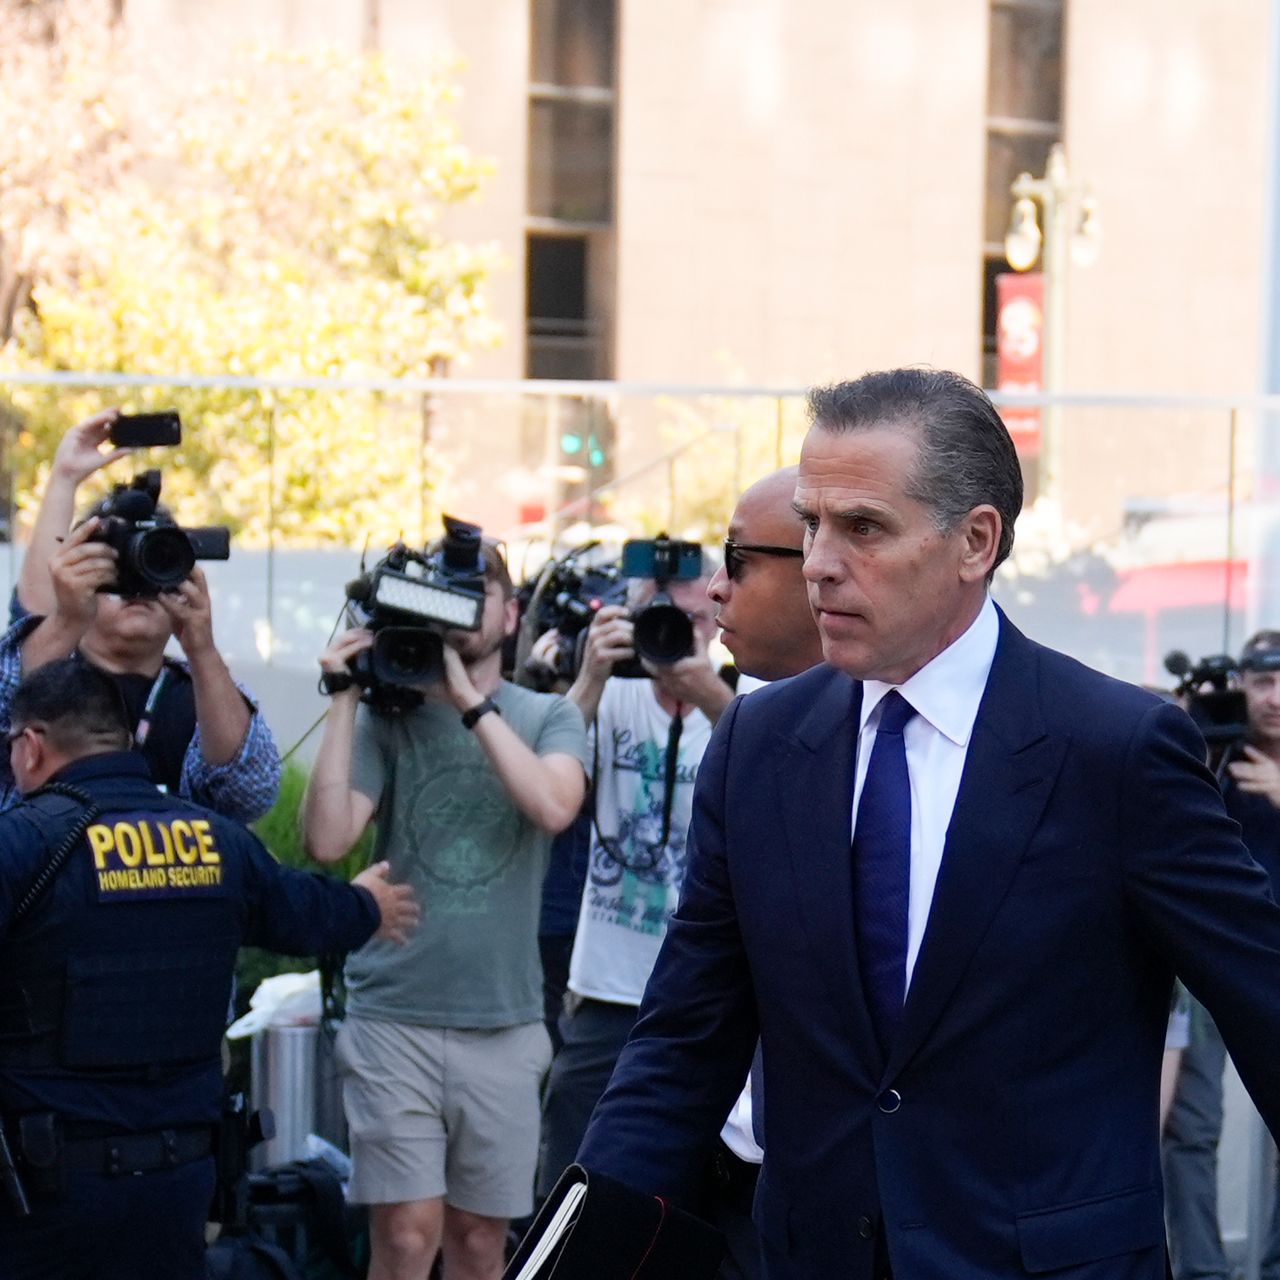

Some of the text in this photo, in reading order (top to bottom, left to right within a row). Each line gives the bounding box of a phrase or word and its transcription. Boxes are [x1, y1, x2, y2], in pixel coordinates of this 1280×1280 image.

[87, 819, 220, 869] POLICE
[98, 865, 222, 892] HOMELAND SECURITY
